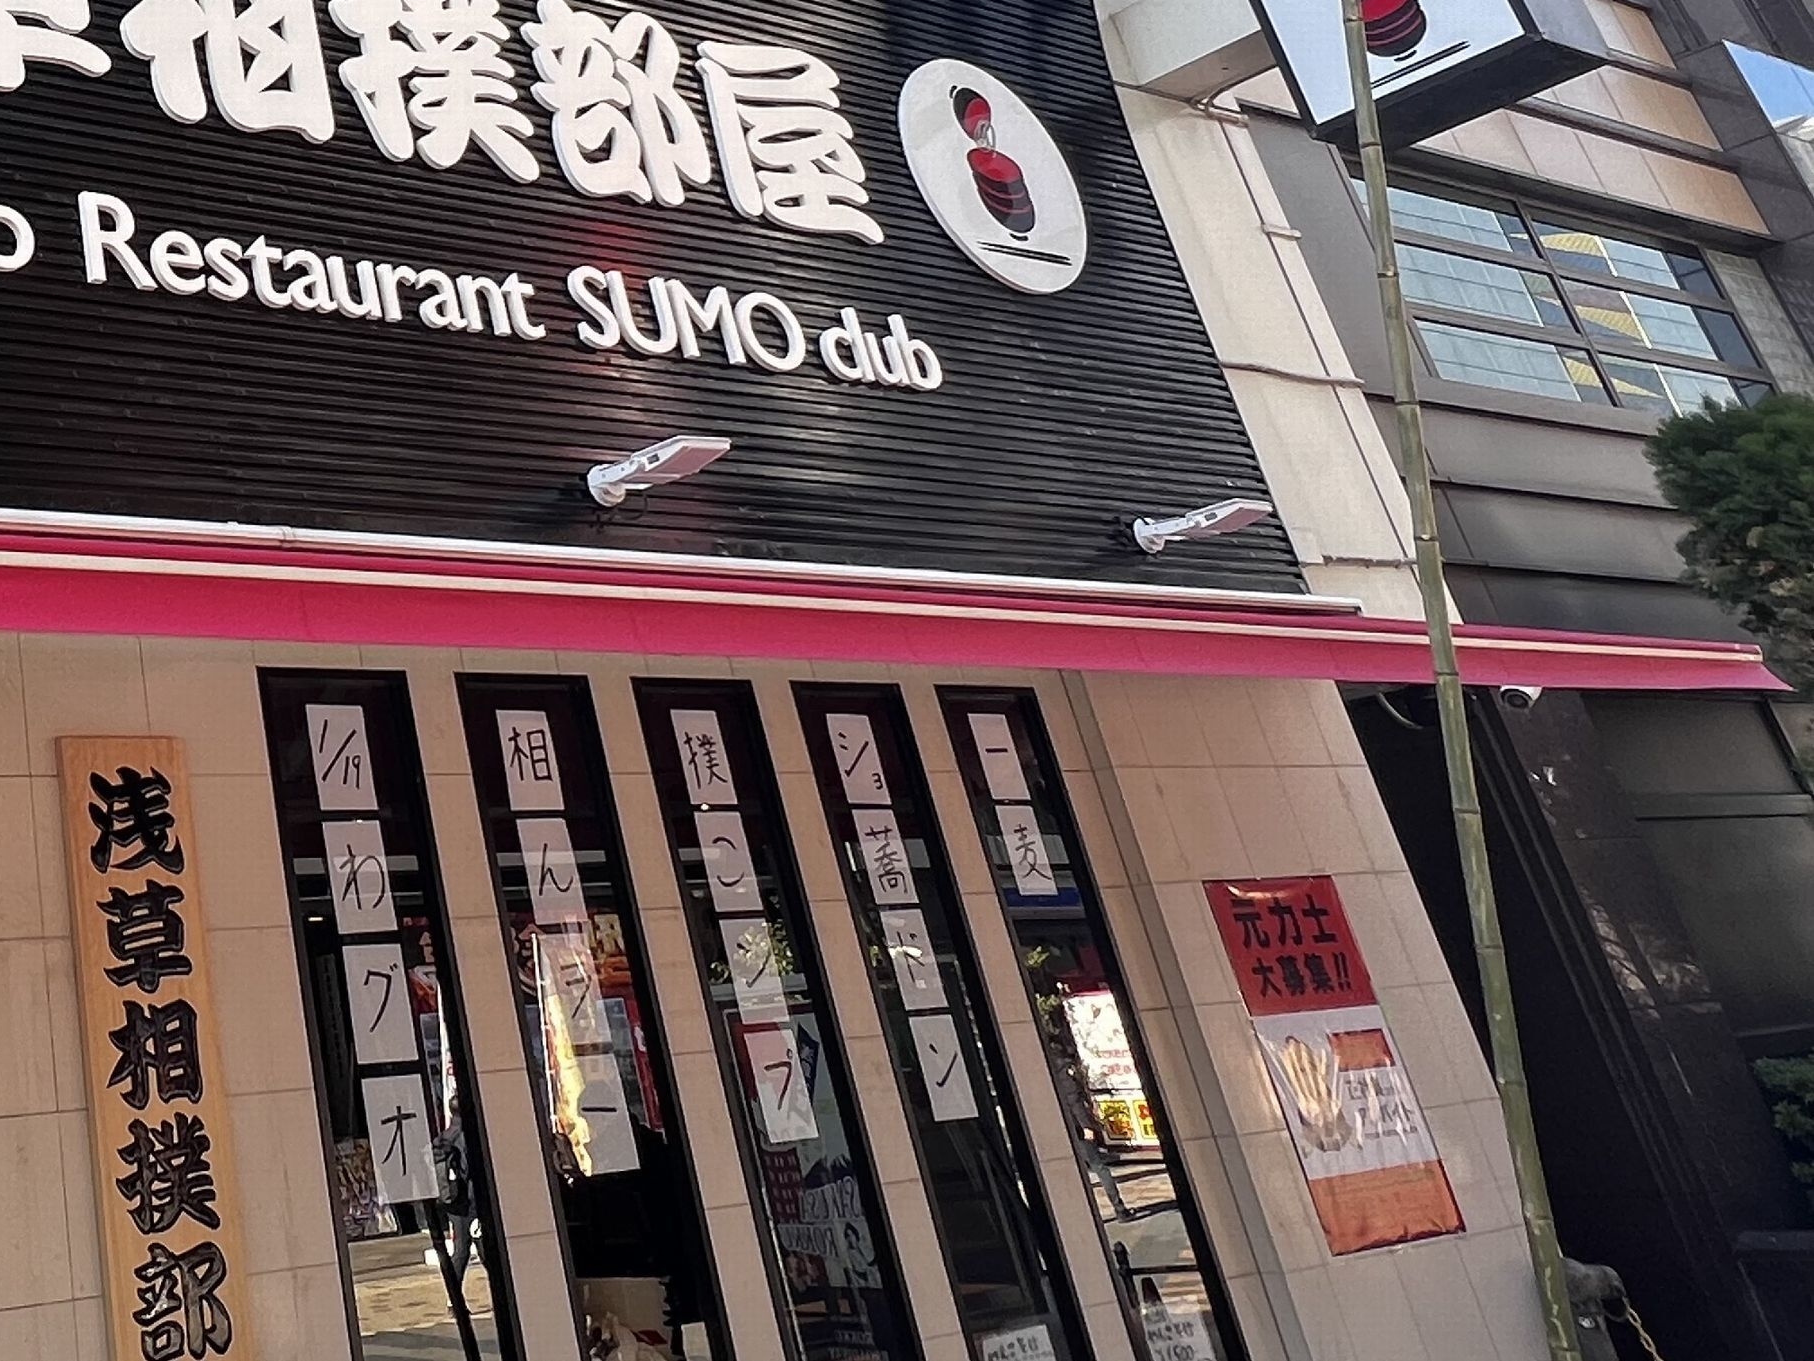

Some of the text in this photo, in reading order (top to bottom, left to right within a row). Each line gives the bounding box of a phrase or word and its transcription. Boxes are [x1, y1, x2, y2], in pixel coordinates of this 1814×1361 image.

[77, 190, 546, 342] Restaurant
[567, 264, 807, 372] SUMO
[819, 307, 943, 392] club
[319, 719, 362, 790] 1/19
[1230, 893, 1338, 949] 元力士
[1251, 951, 1353, 998] 大募集!!
